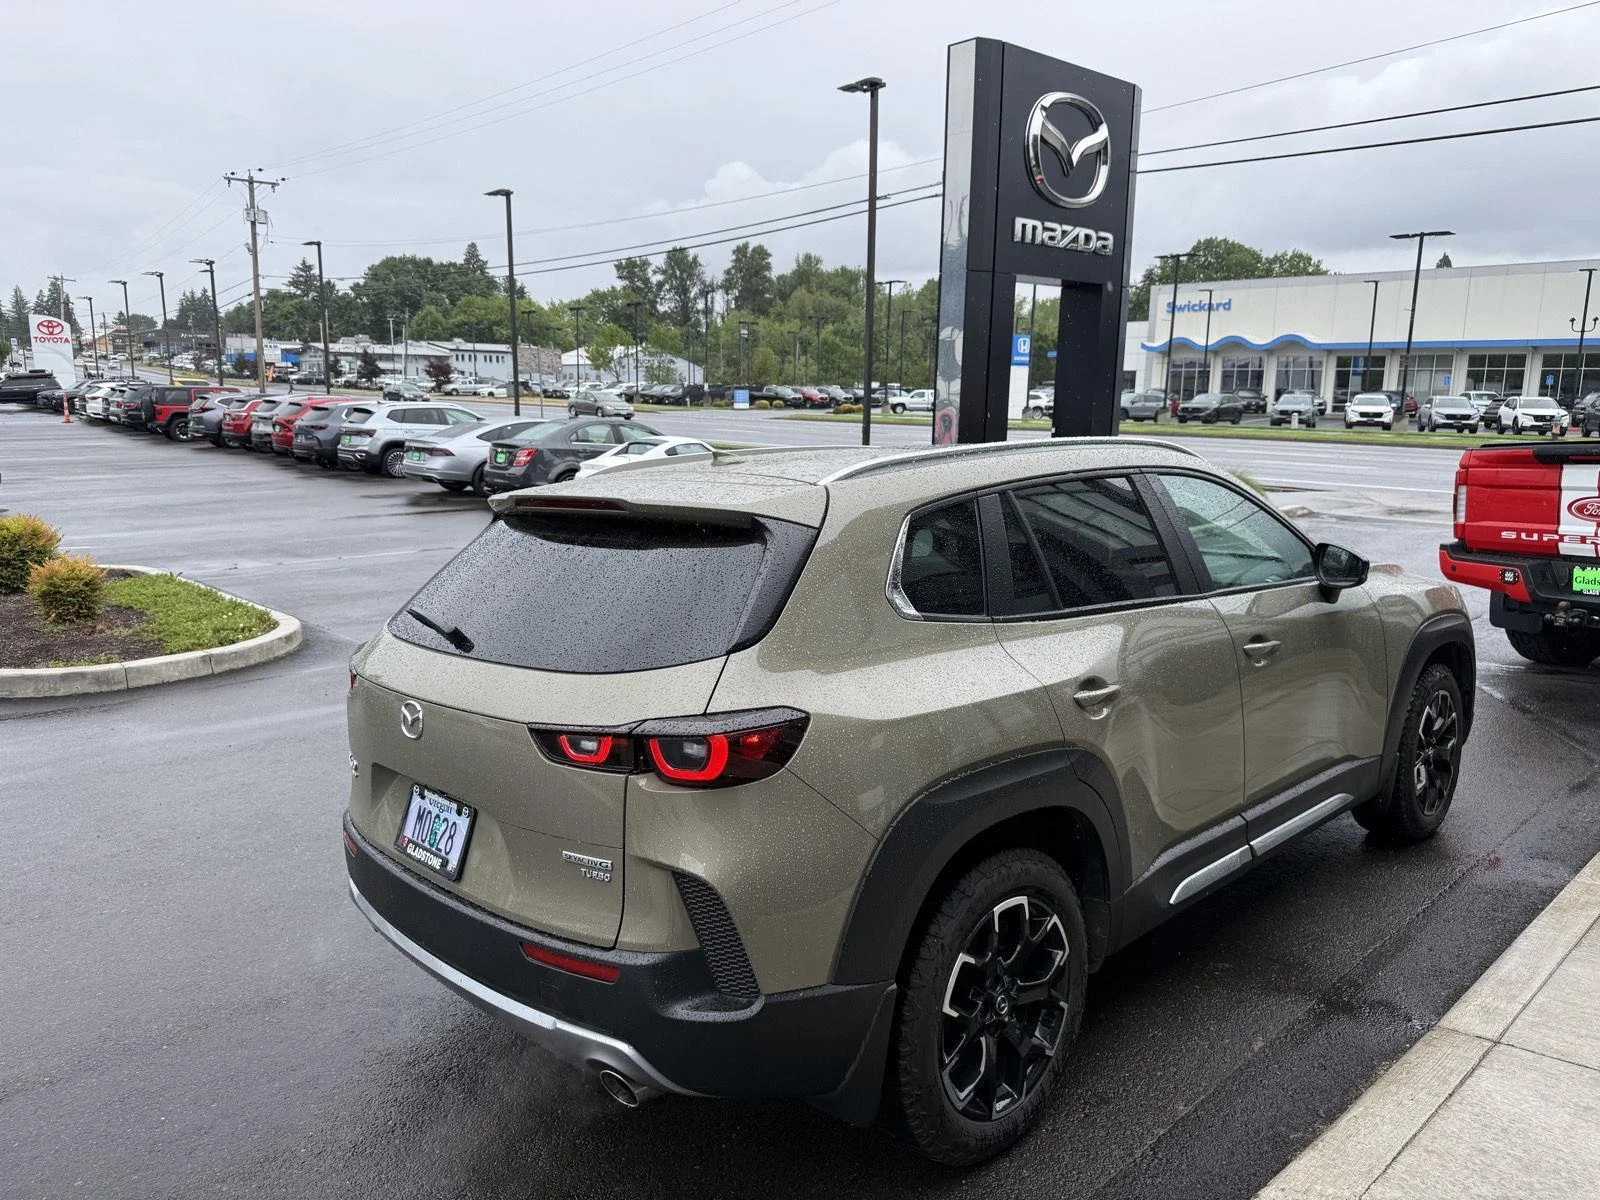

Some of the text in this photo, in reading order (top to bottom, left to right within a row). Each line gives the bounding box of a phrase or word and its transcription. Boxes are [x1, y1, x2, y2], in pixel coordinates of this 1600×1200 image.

[33, 336, 71, 344] TOYOTA
[406, 843, 442, 870] GLADSTONE
[580, 868, 610, 882] TURBO
